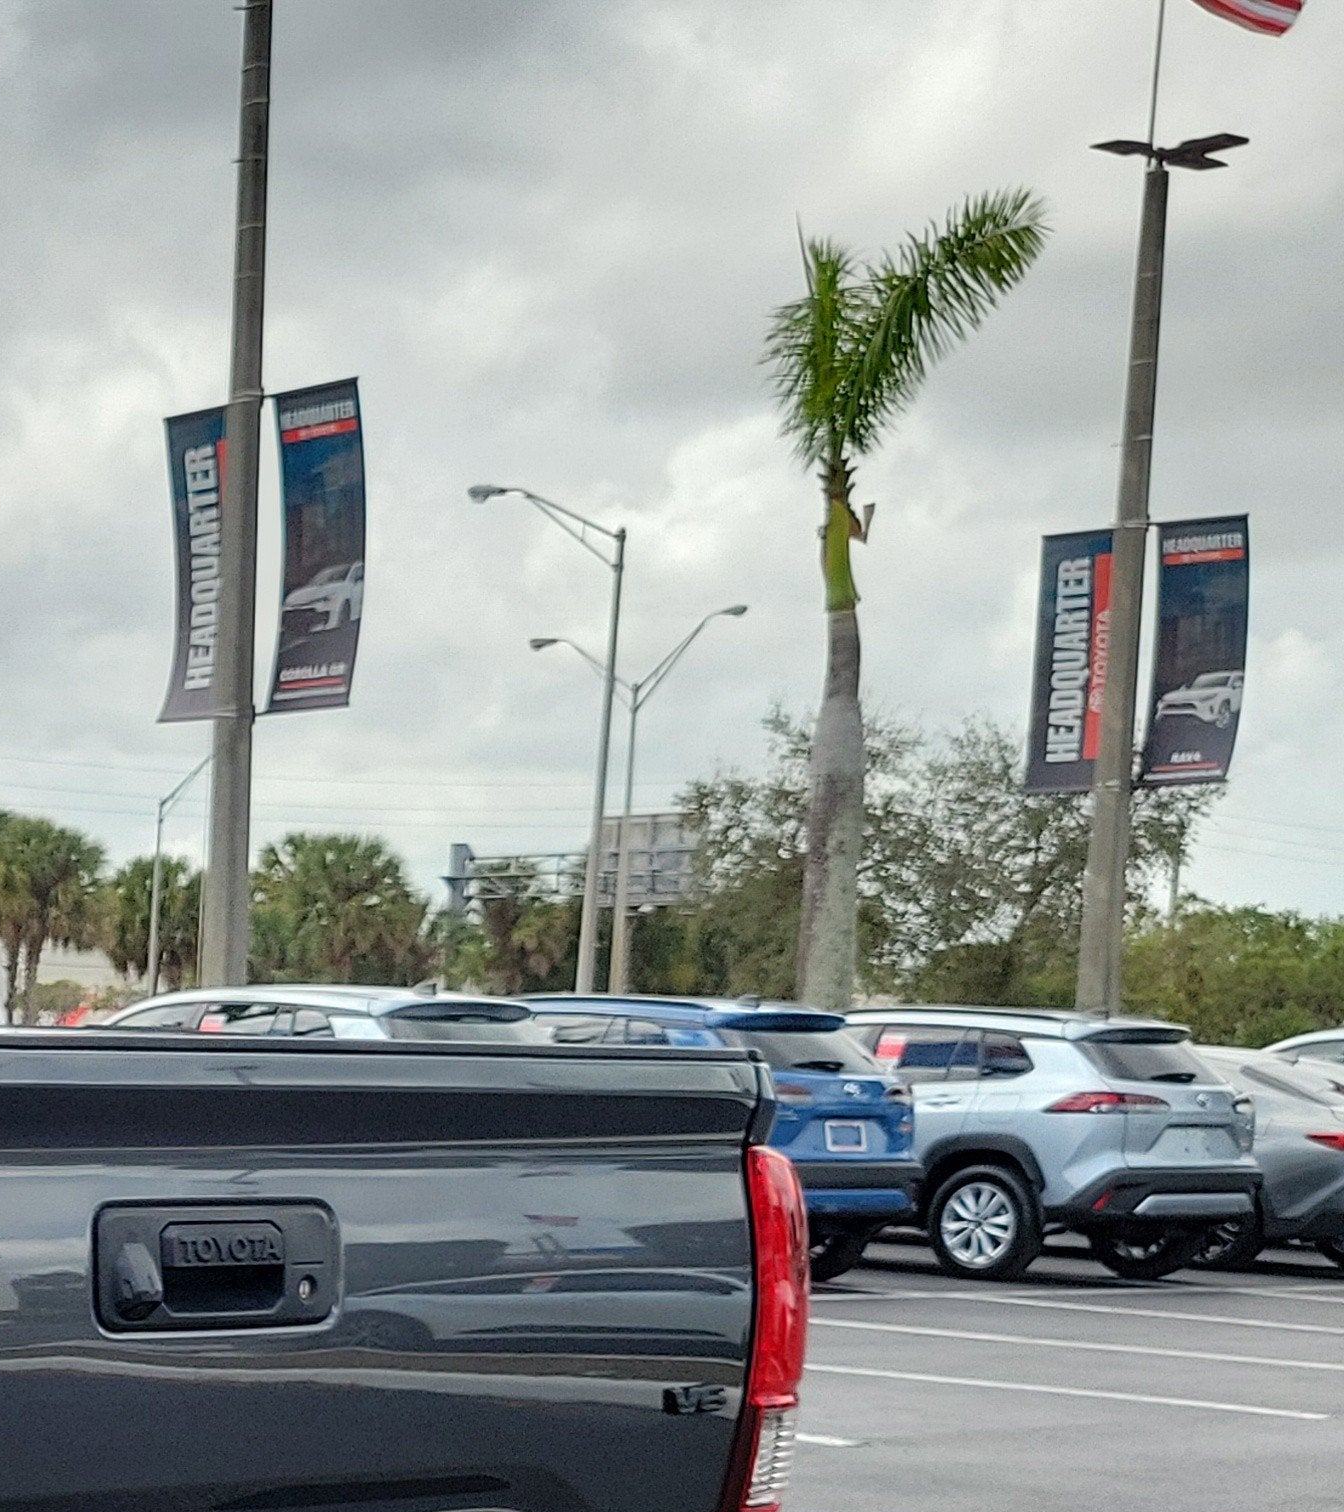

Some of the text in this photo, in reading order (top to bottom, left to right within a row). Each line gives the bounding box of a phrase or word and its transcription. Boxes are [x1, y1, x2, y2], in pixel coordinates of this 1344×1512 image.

[184, 444, 221, 690] HEADQUARTER
[1045, 556, 1092, 763] HEADQUARTER
[178, 1235, 282, 1263] TOYOTA
